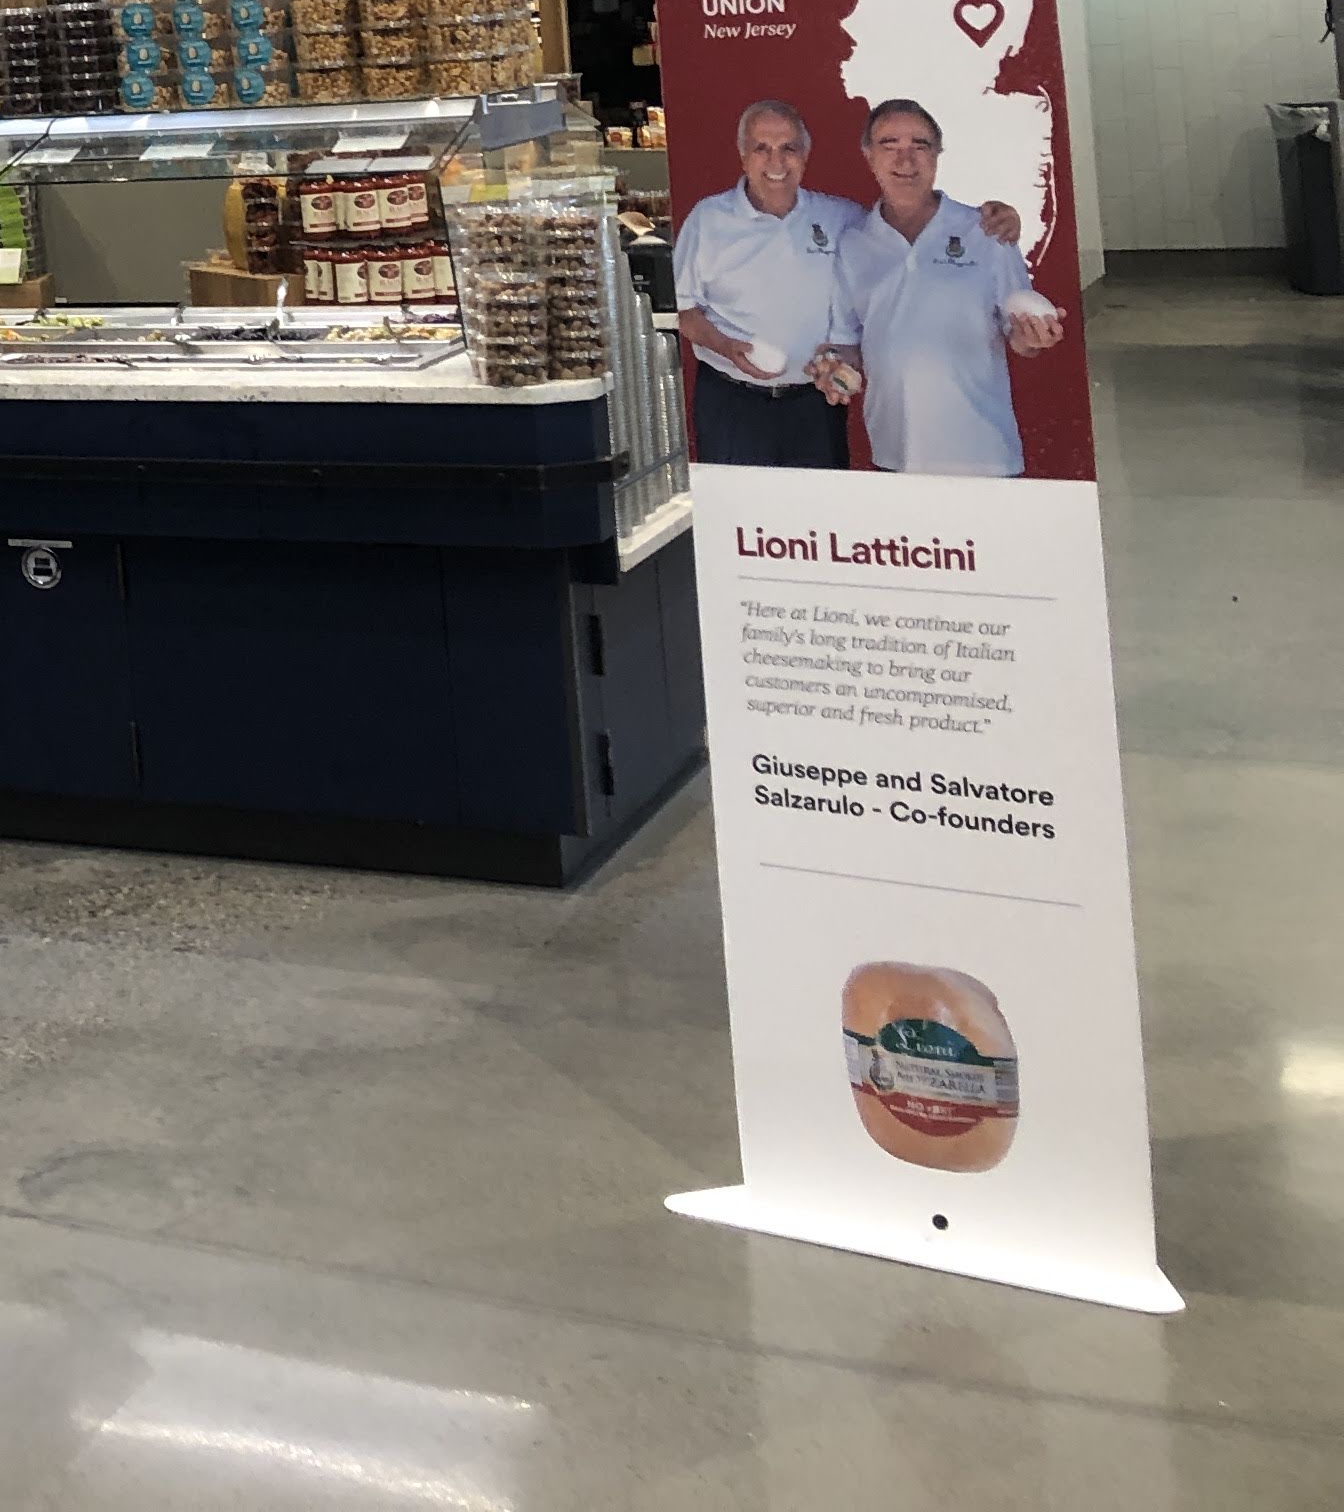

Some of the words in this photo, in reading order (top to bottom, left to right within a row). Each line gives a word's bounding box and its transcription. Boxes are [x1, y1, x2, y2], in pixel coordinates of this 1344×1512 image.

[704, 23, 741, 39] New
[744, 21, 797, 40] Jersey
[736, 527, 818, 562] Lioni
[830, 531, 977, 572] Latticini
[790, 608, 807, 620] at
[813, 605, 860, 626] Lioni,
[864, 613, 890, 627] we
[895, 614, 973, 633] continue
[978, 621, 1011, 636] our
[741, 622, 805, 647] family's
[810, 628, 847, 652] long
[851, 634, 927, 654] tradition
[933, 640, 955, 660] of
[956, 641, 1016, 662] Italian
[743, 647, 862, 677] cheesemaking
[867, 661, 884, 675] to
[888, 659, 937, 684] bring
[940, 669, 973, 682] our
[745, 675, 831, 695] customers
[836, 684, 858, 697] an
[864, 686, 1013, 713] uncompromised,
[747, 699, 816, 717] superior
[821, 705, 855, 720] and
[859, 705, 904, 726] fresh
[752, 753, 868, 788] Giuseppe
[875, 771, 922, 792] and
[930, 773, 1054, 807] Salvatore
[754, 785, 865, 818] Salzarulo
[890, 801, 1056, 840] Co-founders
